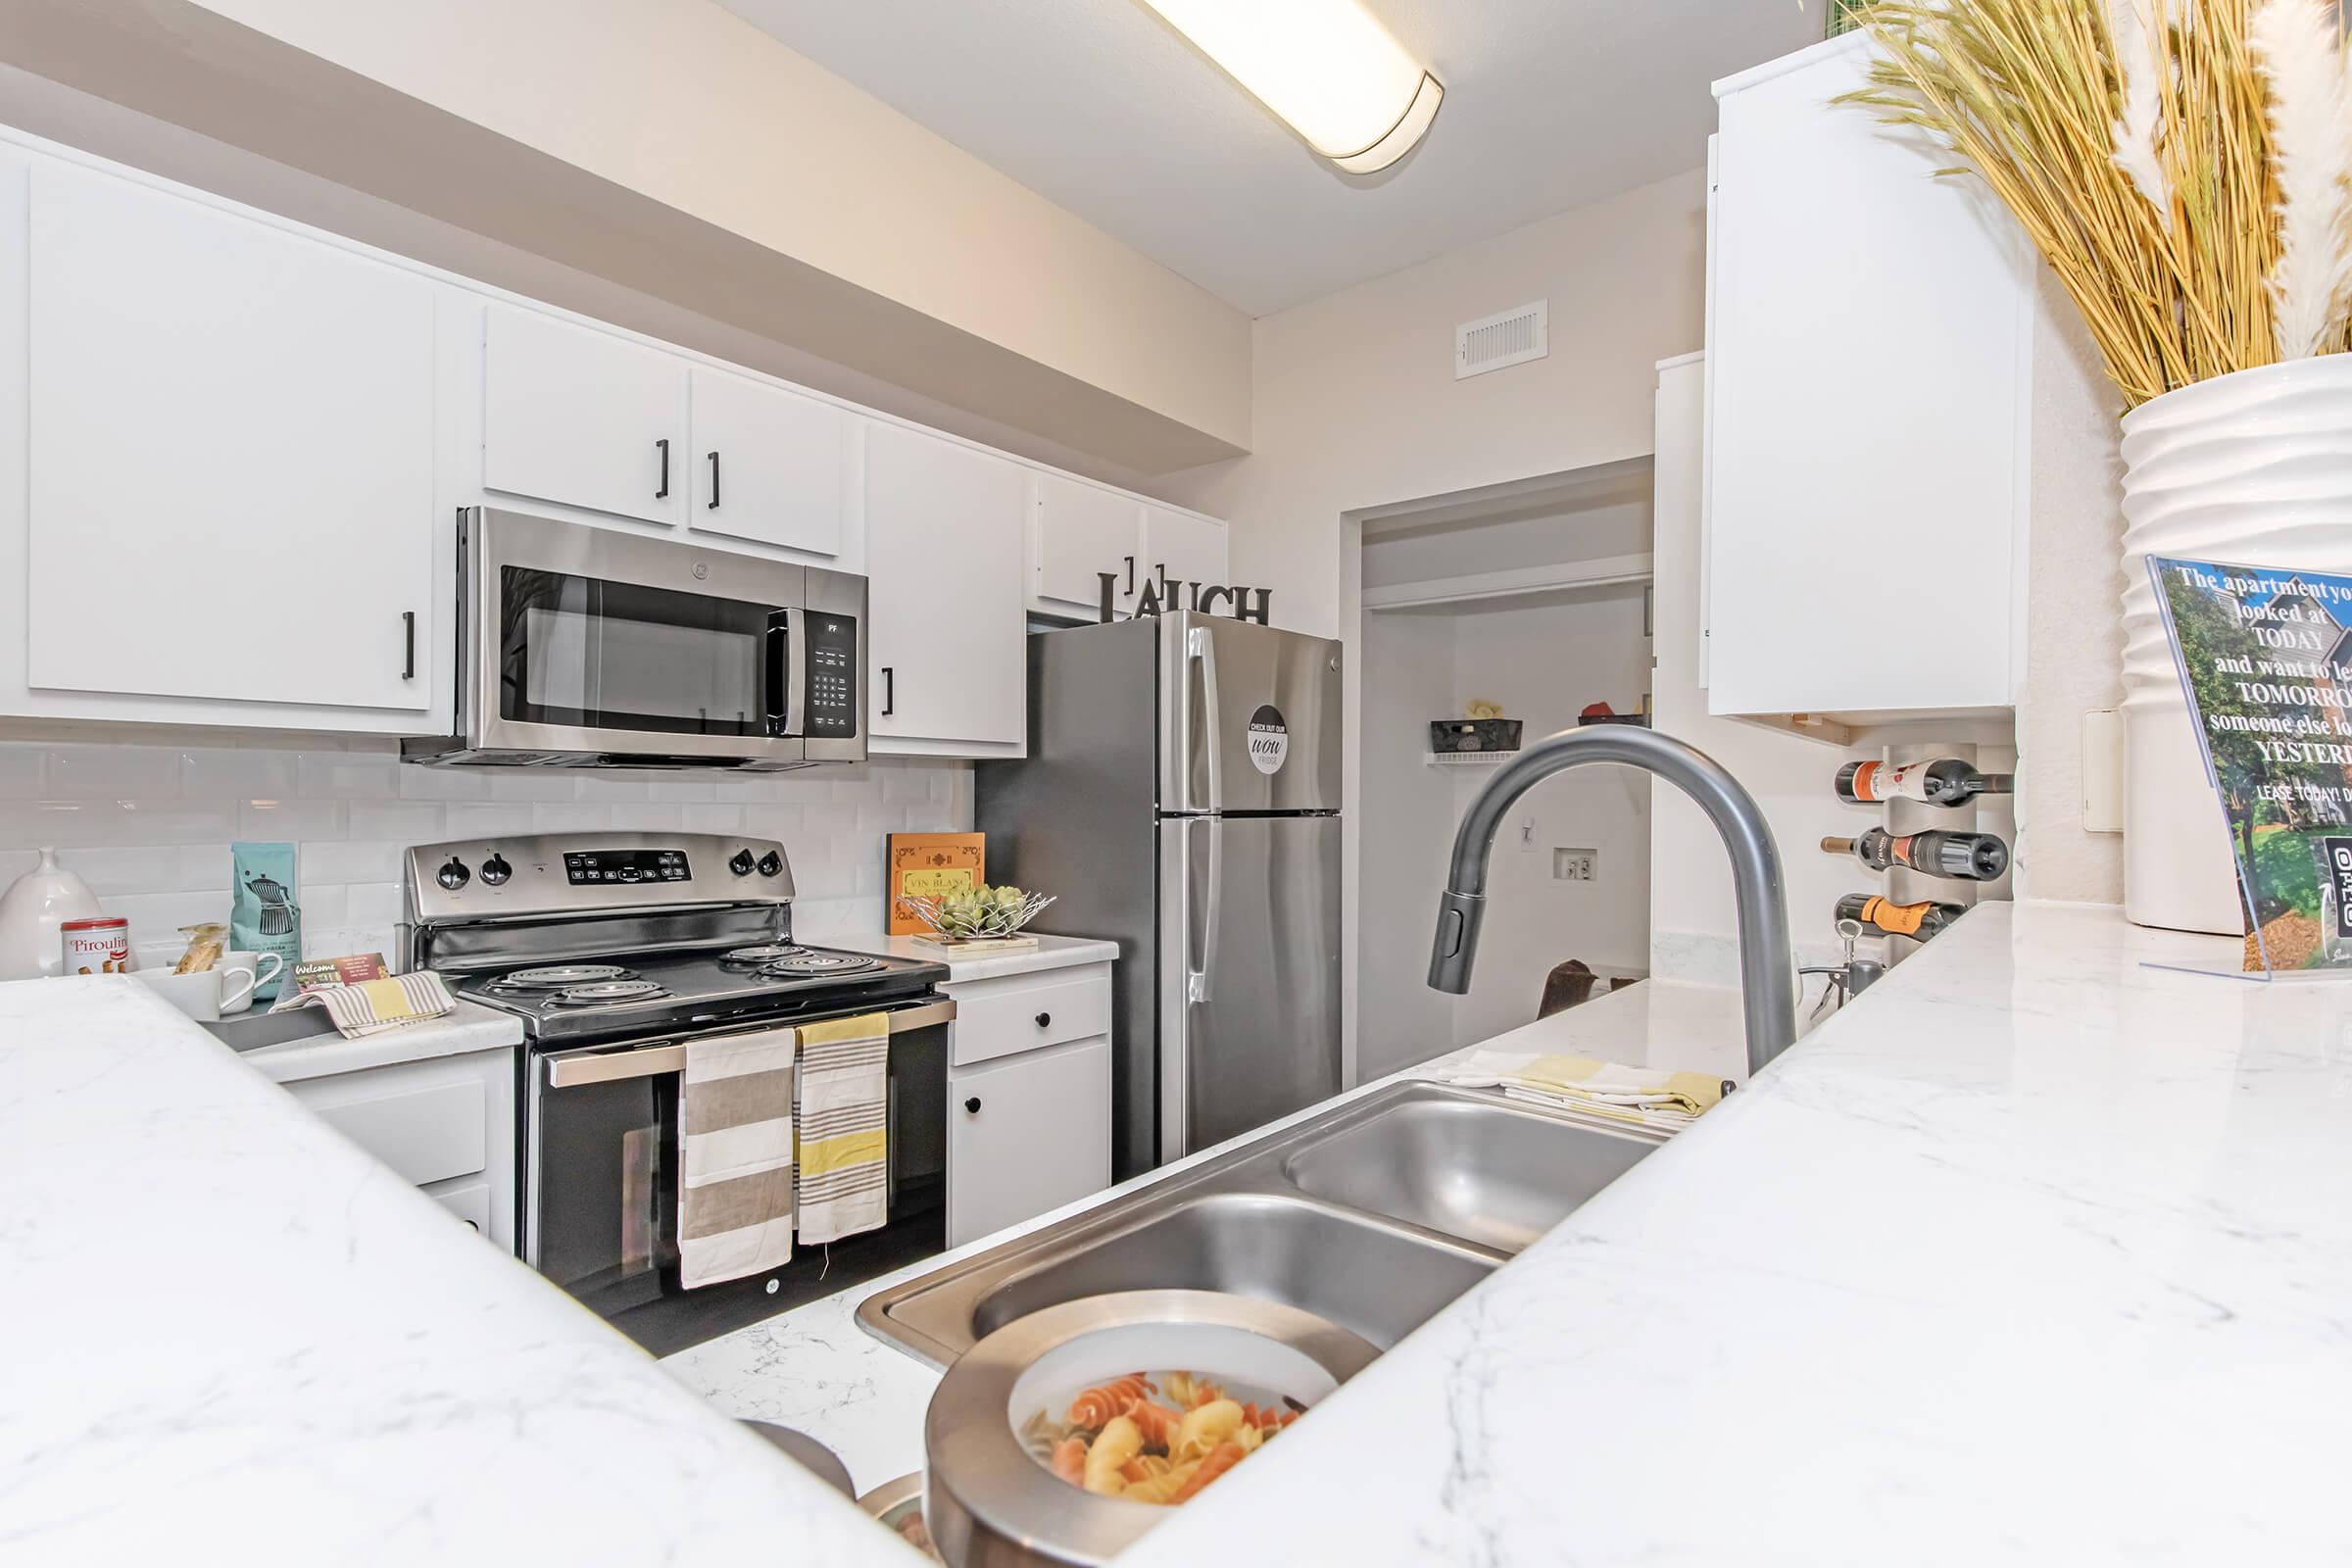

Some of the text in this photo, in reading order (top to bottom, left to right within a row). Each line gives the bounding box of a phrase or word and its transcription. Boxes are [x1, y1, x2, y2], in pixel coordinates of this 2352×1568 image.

[2176, 566, 2352, 605] The apartment yo
[2235, 599, 2328, 625] looked at
[2251, 627, 2323, 651] TODAY
[2214, 655, 2352, 681] and want to le
[2234, 681, 2352, 710] TOMORRO
[1250, 722, 1265, 731] CHECK
[2210, 713, 2293, 734] someone
[2296, 713, 2331, 736] else
[1258, 756, 1278, 765] FRIDGE
[2257, 785, 2294, 801] LEASE
[2294, 786, 2341, 803] TODAY!
[910, 878, 929, 887] VIN
[295, 963, 336, 975] Welcome
